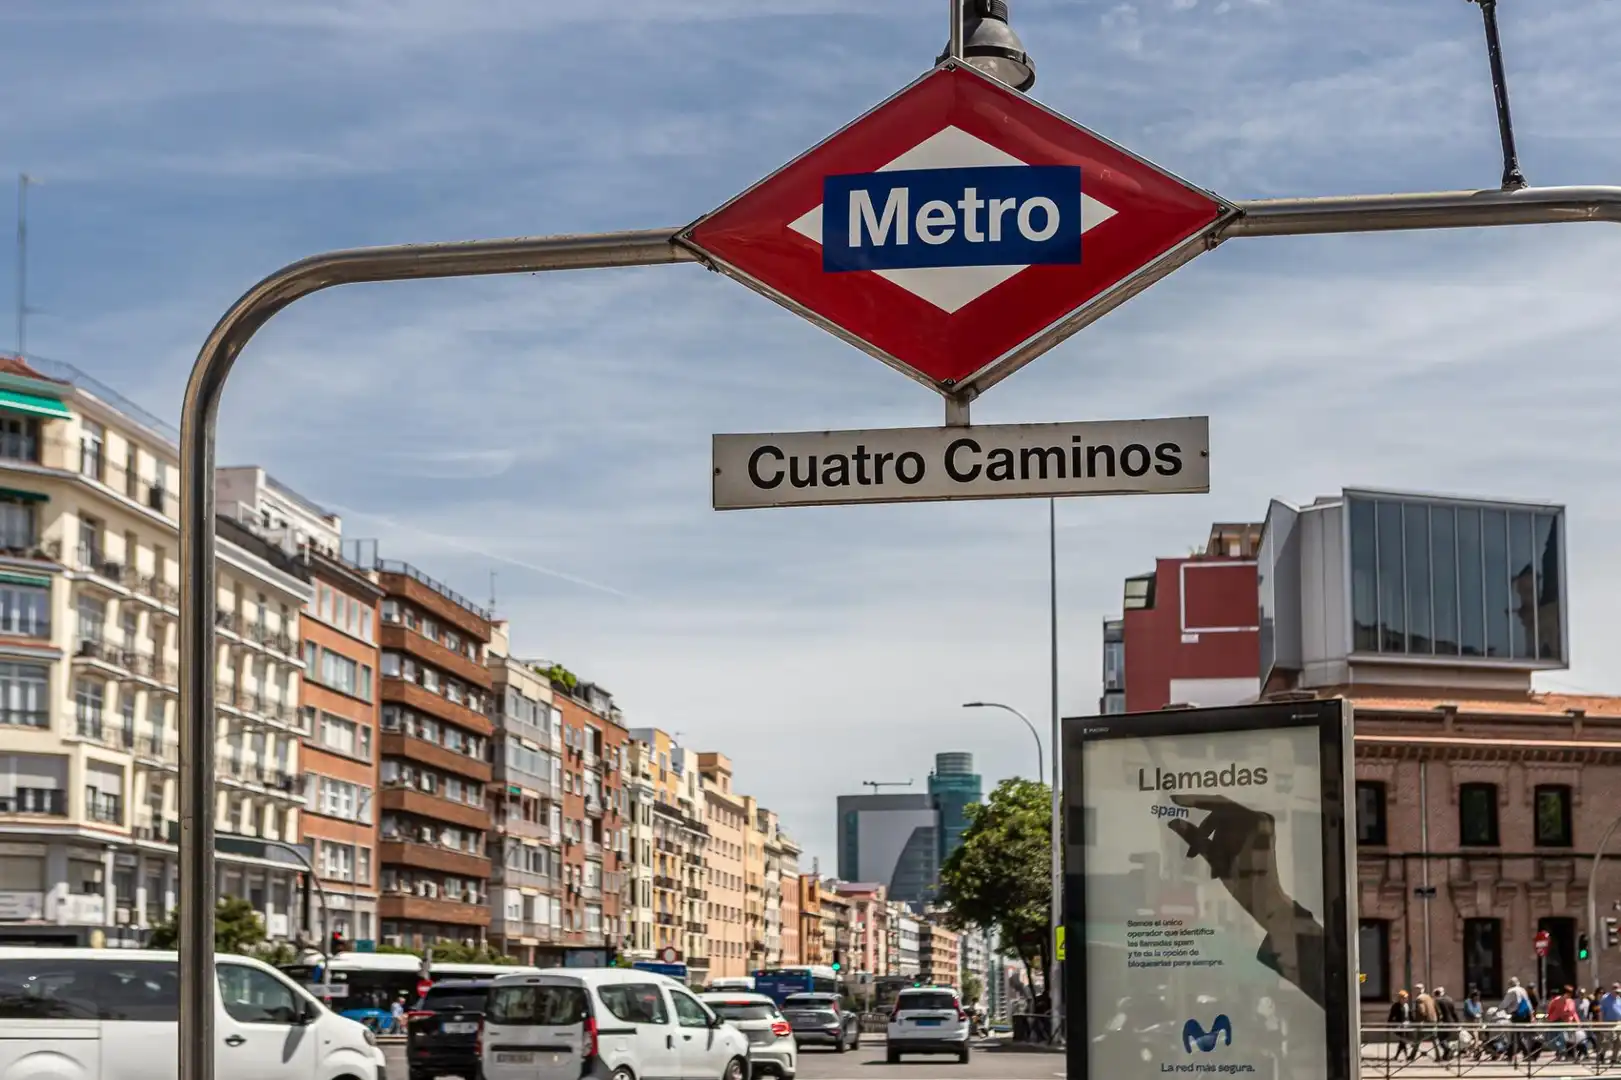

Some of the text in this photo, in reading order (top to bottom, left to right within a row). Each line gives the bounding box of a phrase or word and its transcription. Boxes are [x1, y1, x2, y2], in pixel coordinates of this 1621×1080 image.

[848, 187, 1060, 247] Metro
[747, 435, 1183, 489] Cuatro Caminos
[1138, 763, 1269, 792] Llamadas
[1150, 803, 1189, 818] spam
[1127, 919, 1153, 927] Somos
[1127, 927, 1215, 938] operador que identifica
[1139, 939, 1172, 947] llamadas
[1173, 940, 1194, 948] spam
[1127, 951, 1133, 959] y
[1154, 949, 1161, 957] la
[1162, 948, 1188, 958] opción
[1172, 959, 1191, 968] para
[1161, 1061, 1256, 1074] La red más segura.
